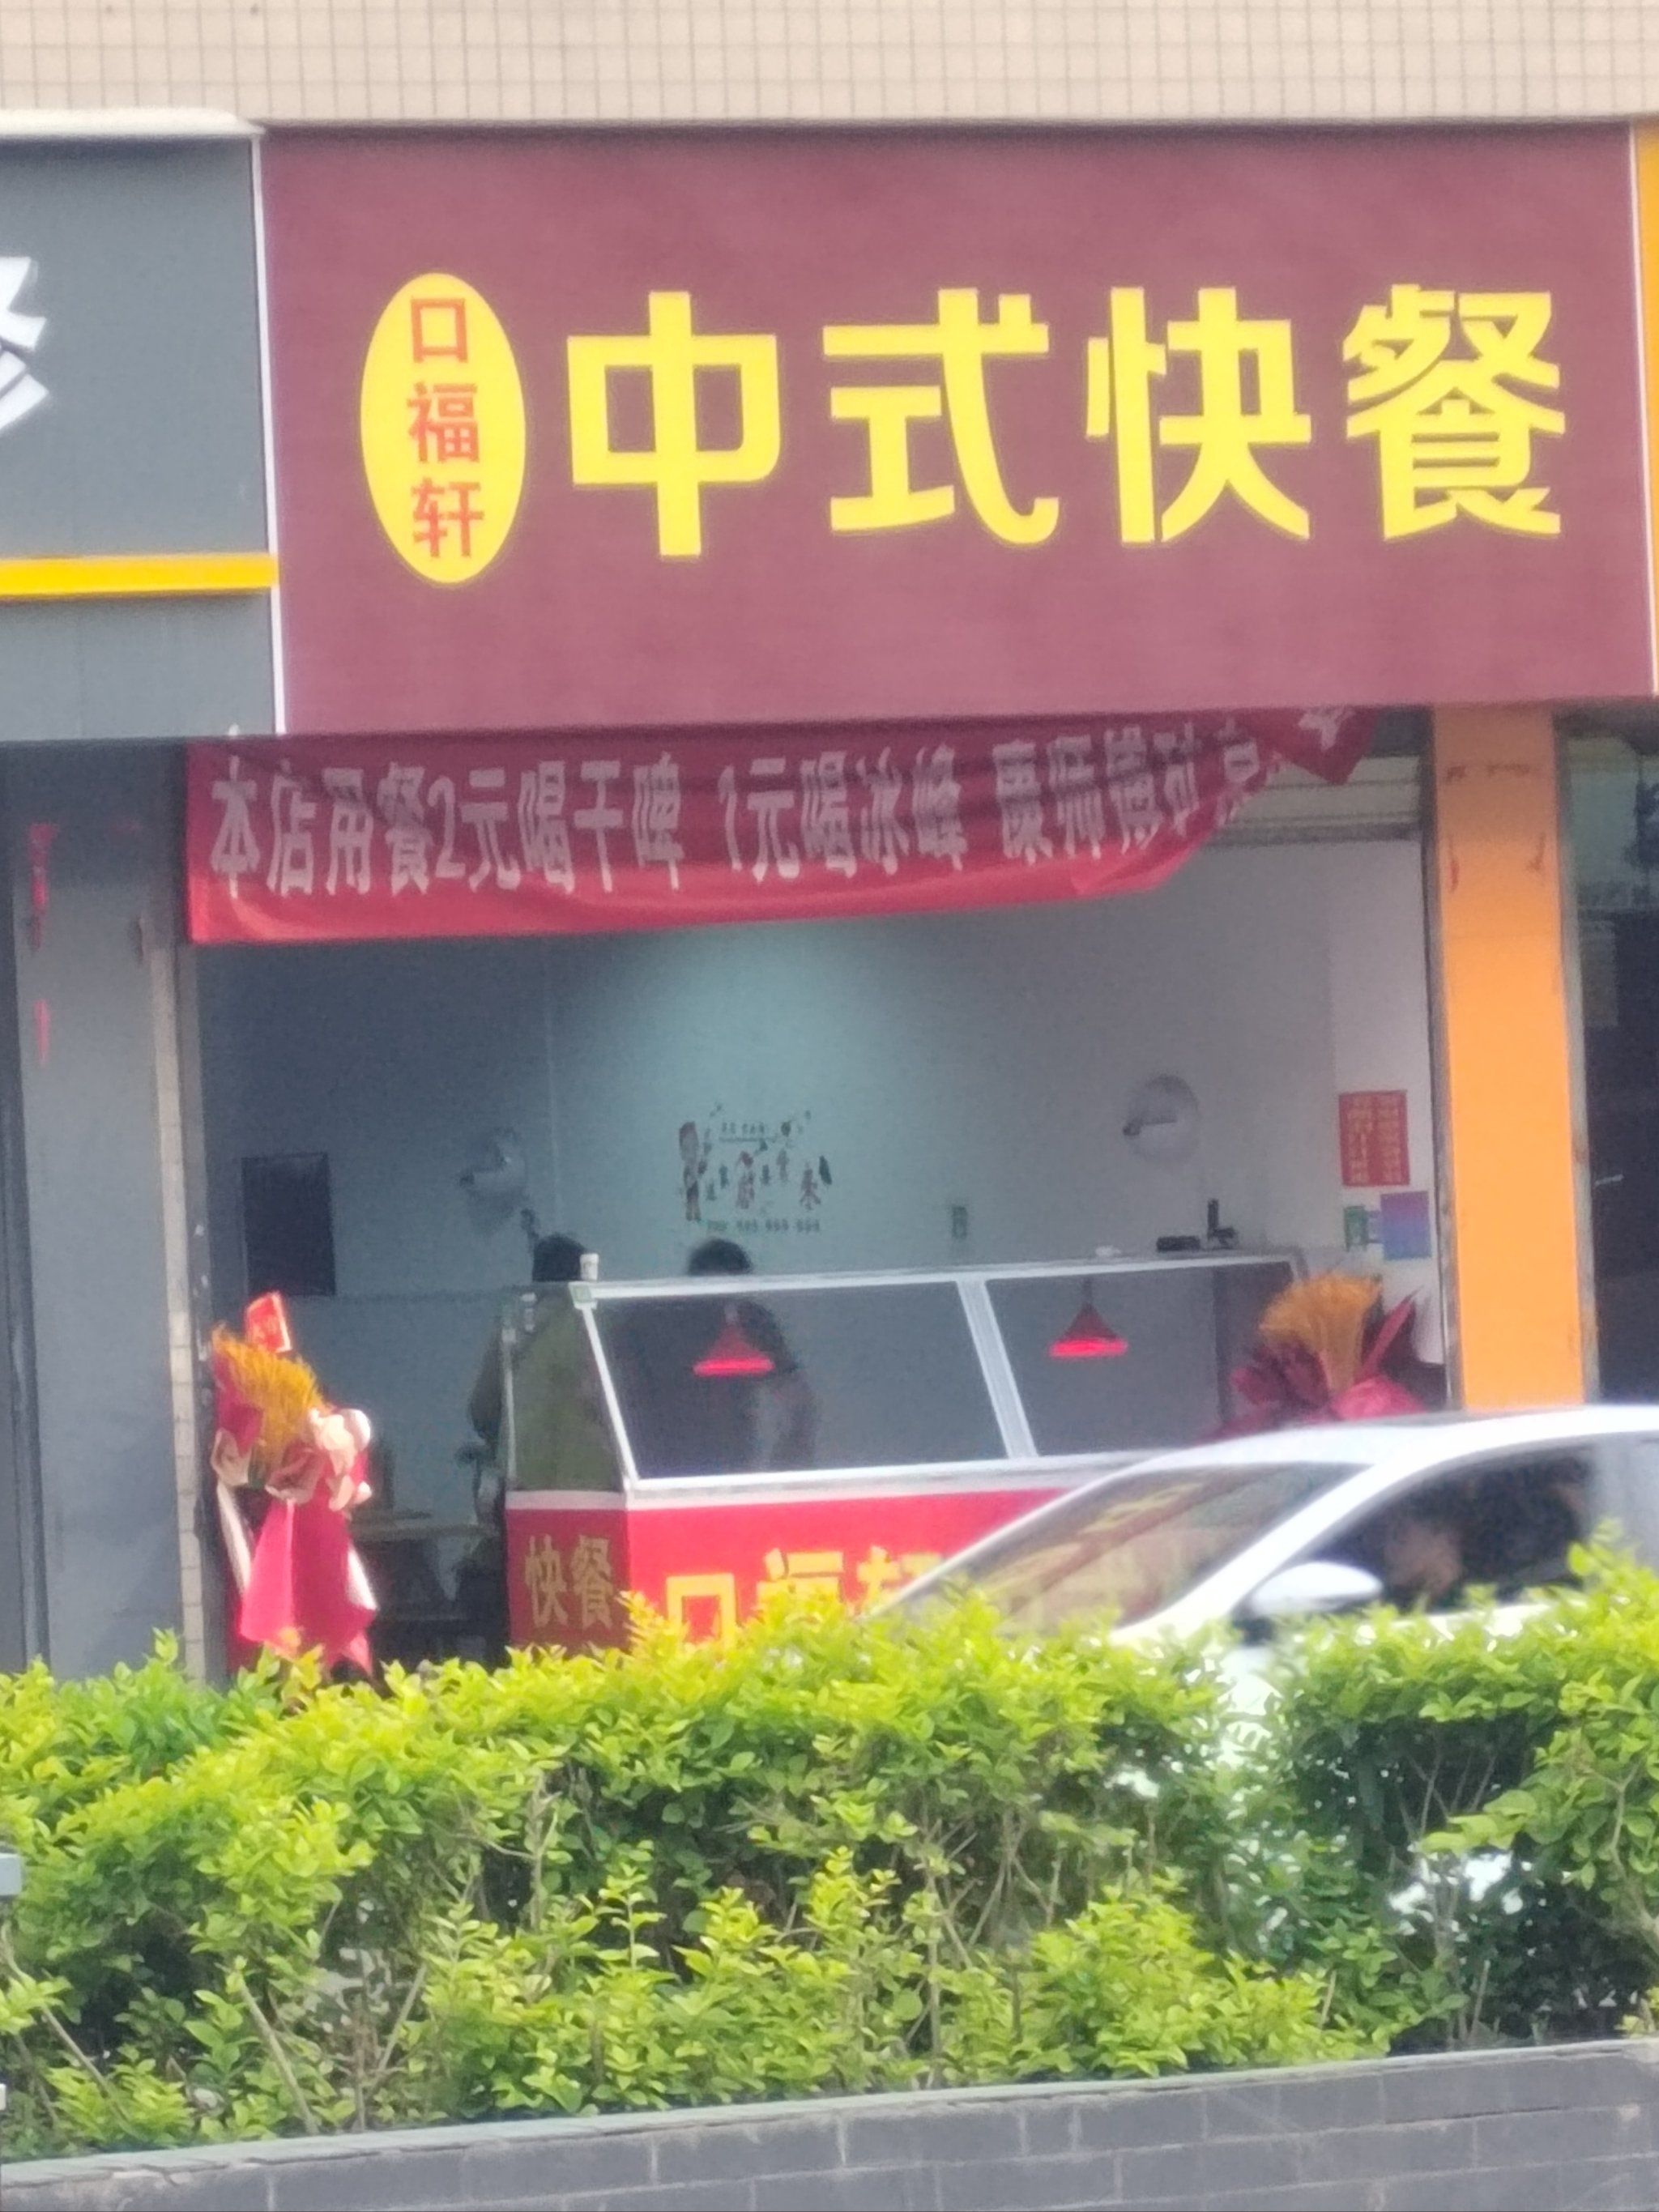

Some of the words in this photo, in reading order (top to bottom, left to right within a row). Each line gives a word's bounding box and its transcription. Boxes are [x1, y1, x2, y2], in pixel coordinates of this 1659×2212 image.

[407, 295, 484, 559] 口福轩
[565, 283, 1567, 559] 中式快餐
[209, 749, 684, 899] 本店用餐2元喝干啤
[524, 1533, 613, 1630] 快餐
